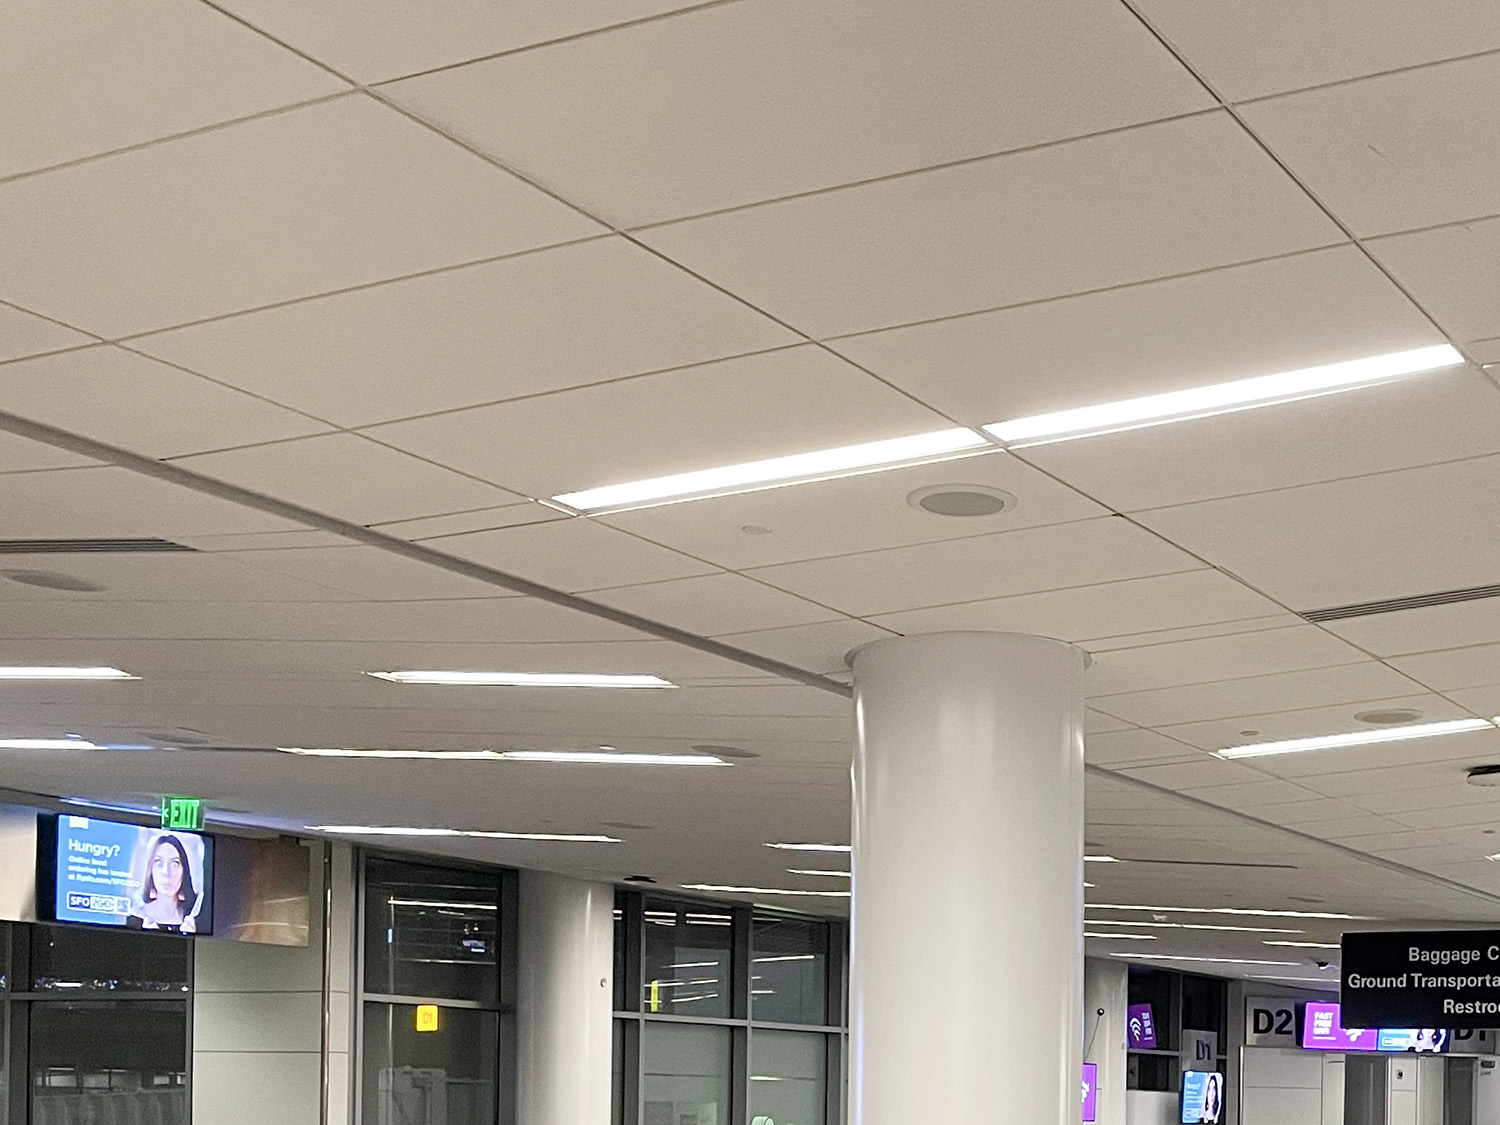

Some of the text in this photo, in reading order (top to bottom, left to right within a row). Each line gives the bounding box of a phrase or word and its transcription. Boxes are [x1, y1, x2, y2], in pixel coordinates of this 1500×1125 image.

[170, 800, 200, 828] EXIT
[68, 838, 120, 857] Hungry?
[1408, 946, 1481, 964] Baggage
[1348, 973, 1407, 989] Ground
[1253, 1008, 1293, 1035] D2
[1195, 1039, 1211, 1060] D1
